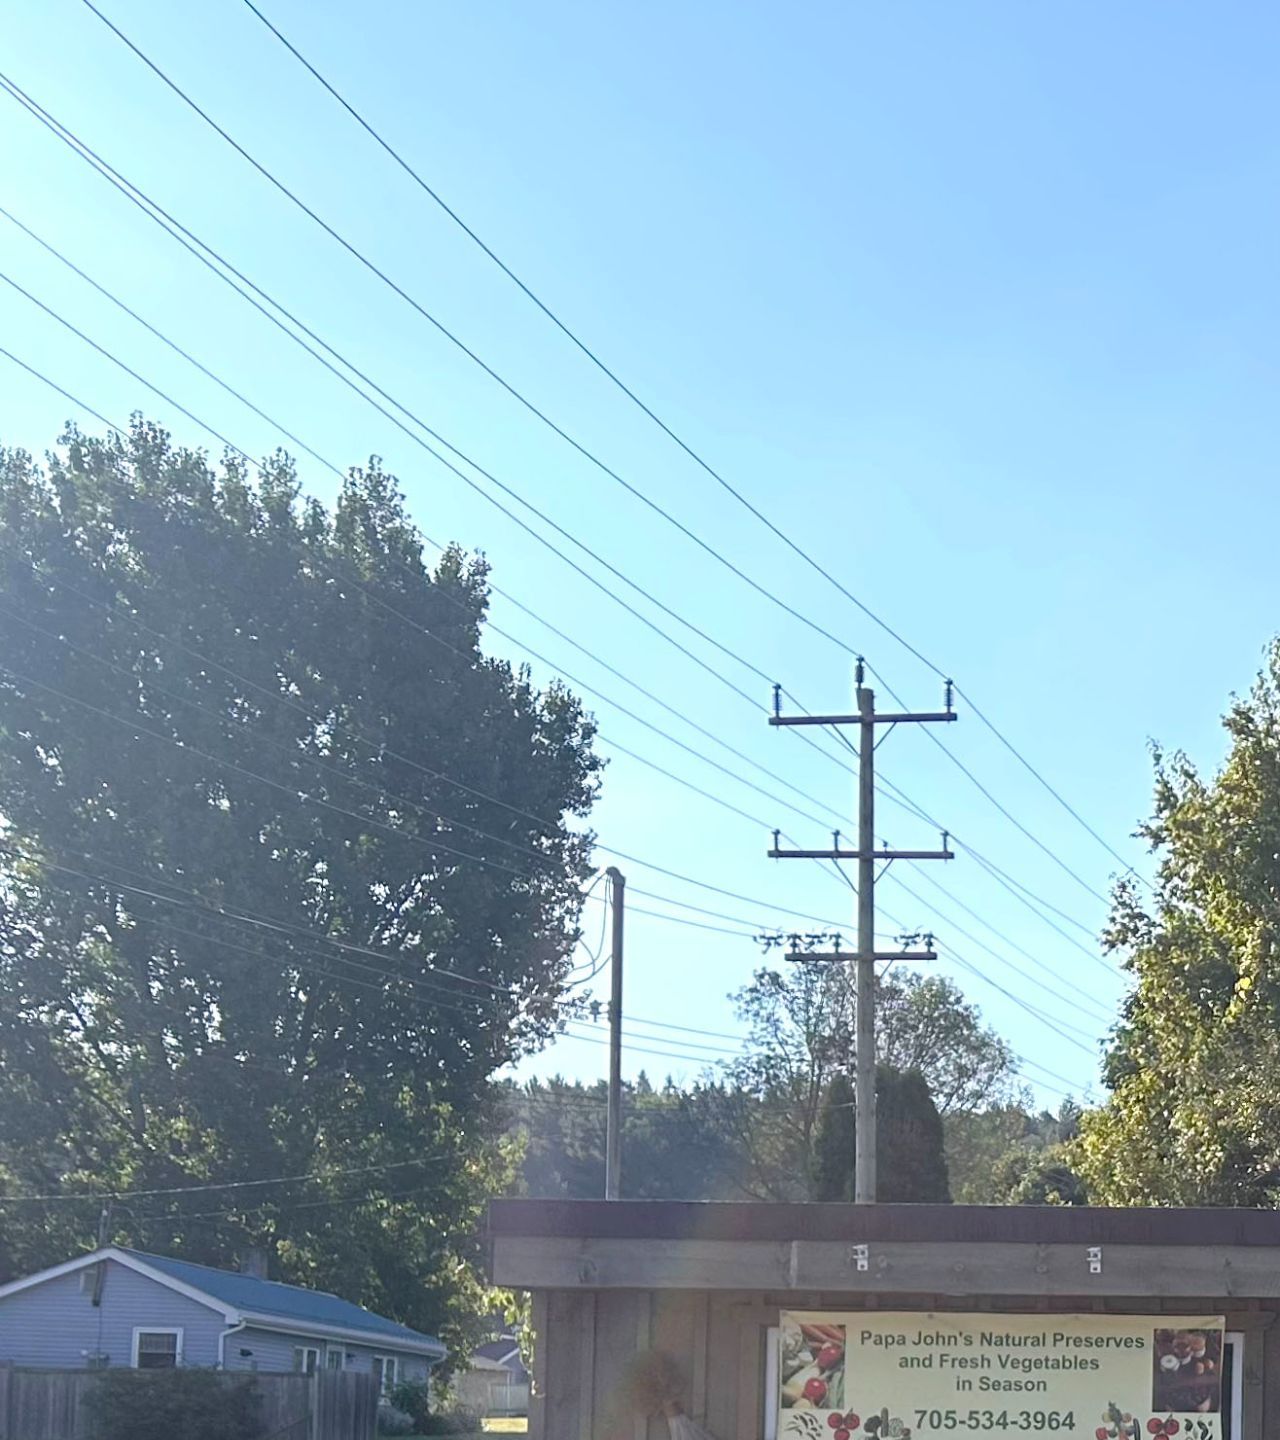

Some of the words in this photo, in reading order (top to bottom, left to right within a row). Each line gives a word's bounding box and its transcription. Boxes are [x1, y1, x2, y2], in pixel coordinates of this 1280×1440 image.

[860, 1331, 906, 1349] Papa
[912, 1331, 973, 1347] John's
[980, 1331, 1046, 1348] Natural
[1052, 1332, 1145, 1349] Preserves
[898, 1353, 933, 1369] and
[939, 1353, 991, 1369] Fresh
[998, 1354, 1100, 1372] Vegetables
[956, 1375, 972, 1391] in
[978, 1376, 1047, 1392] Season
[915, 1410, 1076, 1431] 705-534-3964
